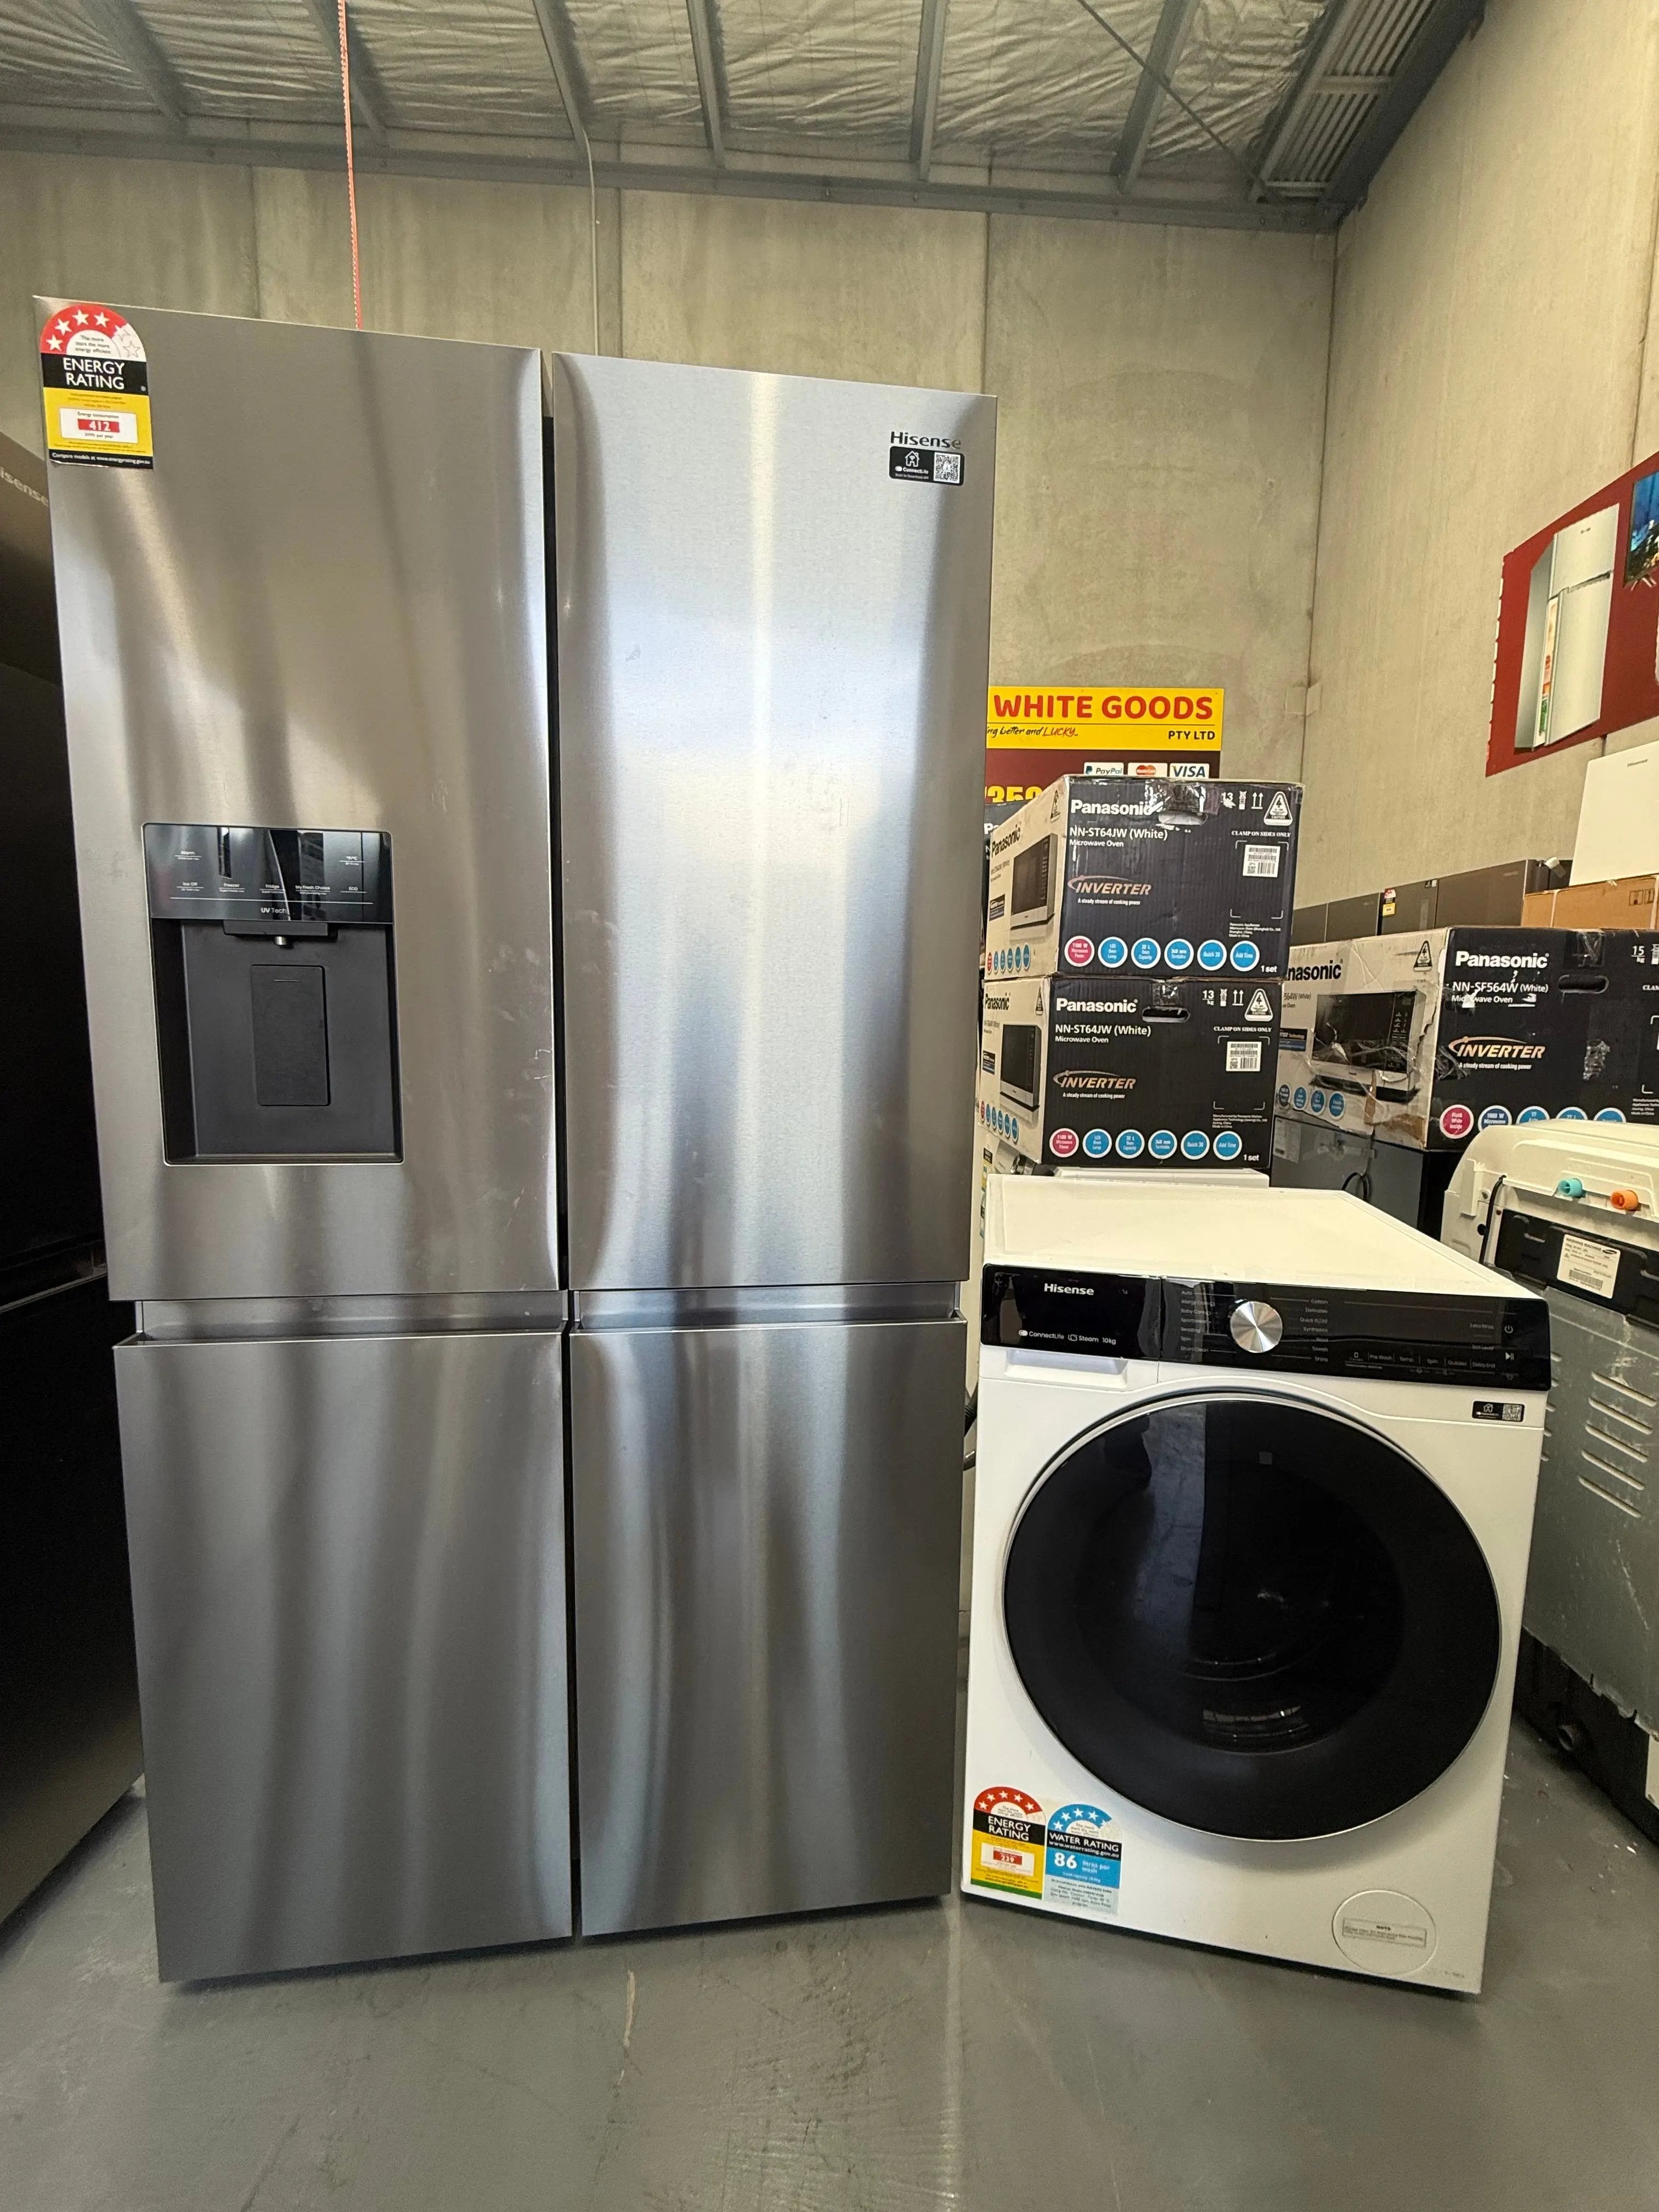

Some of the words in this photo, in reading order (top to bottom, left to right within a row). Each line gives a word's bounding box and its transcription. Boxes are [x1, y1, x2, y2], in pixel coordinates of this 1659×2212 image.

[63, 357, 125, 375] ENERGY
[66, 373, 125, 390] RATING
[89, 421, 111, 431] 412
[890, 431, 961, 450] Hisense
[994, 695, 1093, 718] WHITE
[1102, 696, 1213, 720] GOODS
[1000, 726, 1025, 736] better
[1025, 726, 1044, 736] and
[1167, 730, 1190, 741] PTY
[1194, 730, 1216, 740] LTD
[1172, 766, 1206, 777] VISA
[992, 824, 1020, 857] Panasonic
[1070, 827, 1127, 838] NN-ST64JW
[1129, 829, 1168, 841] (White)
[1075, 882, 1152, 895] INVERTER
[1633, 945, 1645, 955] 15
[1455, 951, 1548, 968] Panasonic
[1452, 981, 1519, 993] NN-SF564W
[1520, 984, 1548, 993] (White)
[985, 992, 1009, 1010] Panasonic
[1203, 990, 1214, 999] 13
[1451, 995, 1492, 1003] Micwave
[1056, 998, 1137, 1013] Panasonic
[1056, 1024, 1112, 1034] NN-ST64JW
[1114, 1025, 1151, 1037] (White)
[1457, 1045, 1545, 1059] INVERTER
[1060, 1077, 1136, 1089] INVERTER
[1043, 1283, 1094, 1295] Hisense
[1029, 1331, 1064, 1339] ConnectLife
[988, 1816, 1031, 1832] ENERGY
[989, 1825, 1029, 1841] RATING
[1049, 1832, 1081, 1845] WATER
[1084, 1839, 1119, 1852] RATING
[1049, 1841, 1119, 1858] www.waterrating.gov.au
[1054, 1852, 1077, 1870] 86
